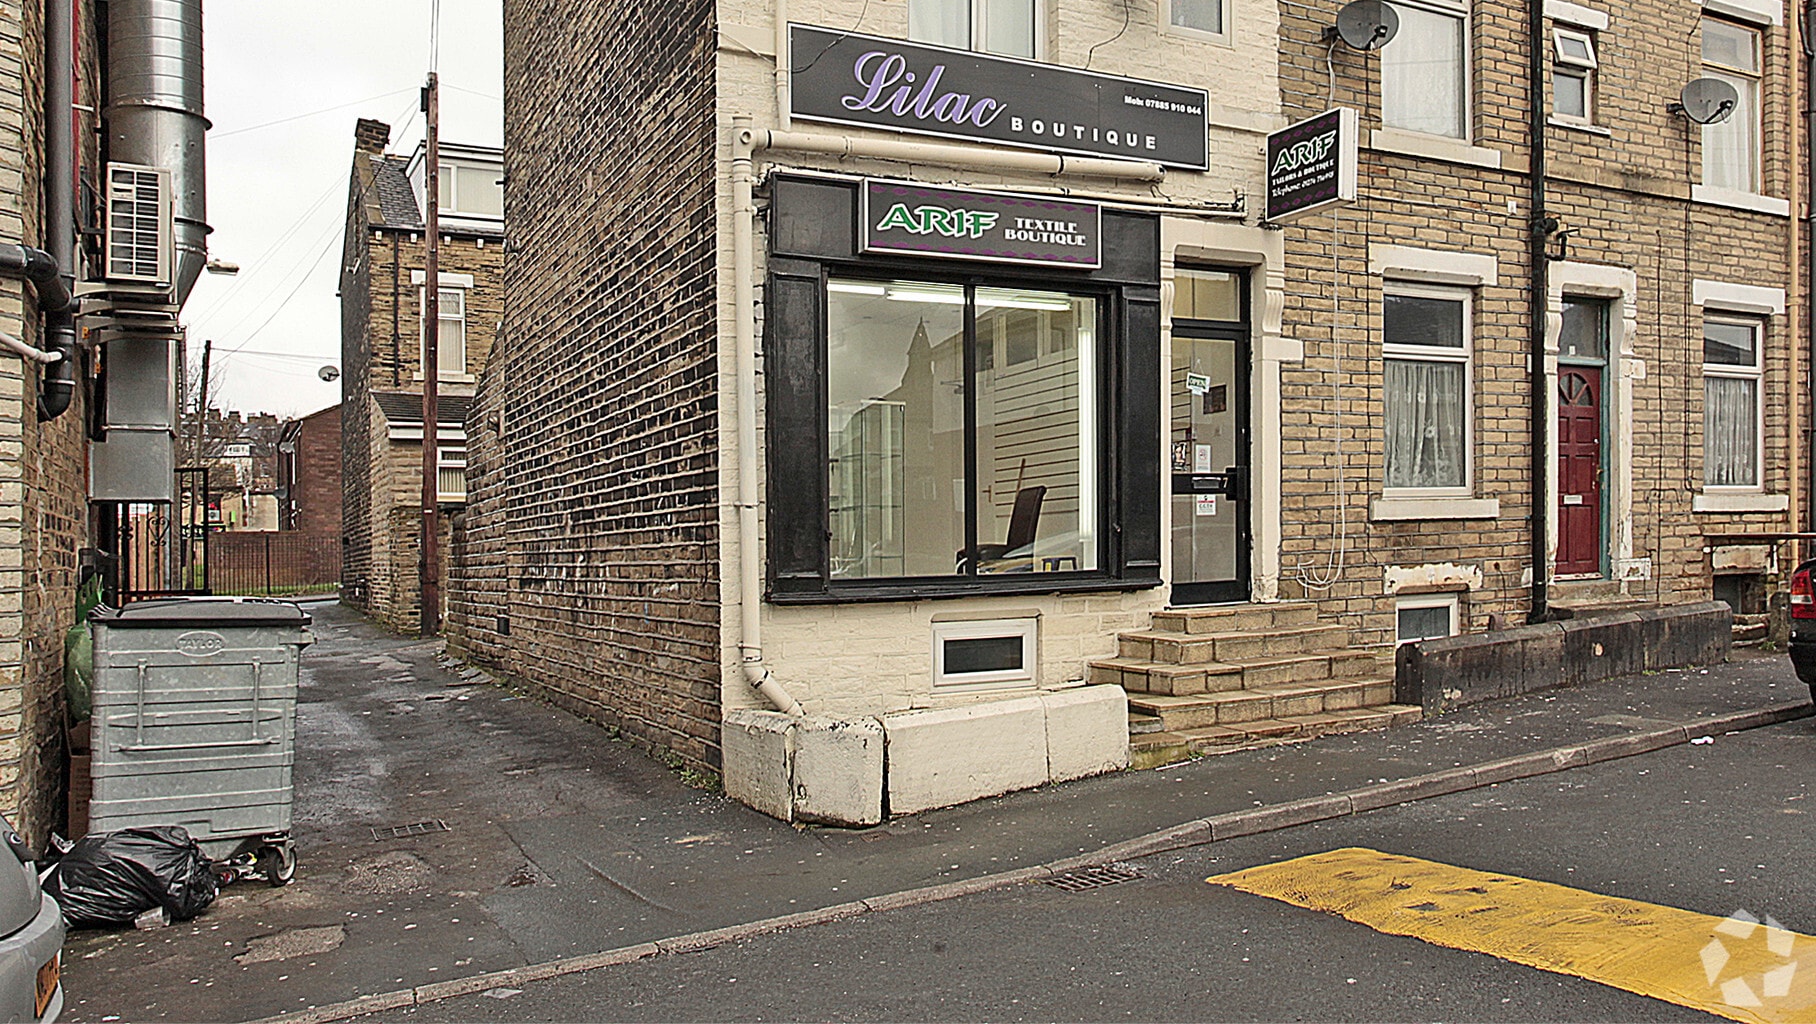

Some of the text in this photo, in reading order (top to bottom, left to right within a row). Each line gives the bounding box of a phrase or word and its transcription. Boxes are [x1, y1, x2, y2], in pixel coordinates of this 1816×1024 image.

[841, 51, 1007, 127] Lilac
[1011, 116, 1157, 150] BOUTIQUE
[1271, 130, 1337, 176] ARIF
[876, 203, 999, 239] ARIF
[1014, 217, 1078, 234] TEXTILE
[1005, 228, 1086, 246] BOUTIQUE
[1222, 477, 1229, 488] 7
[179, 638, 222, 649] TAYLOR
